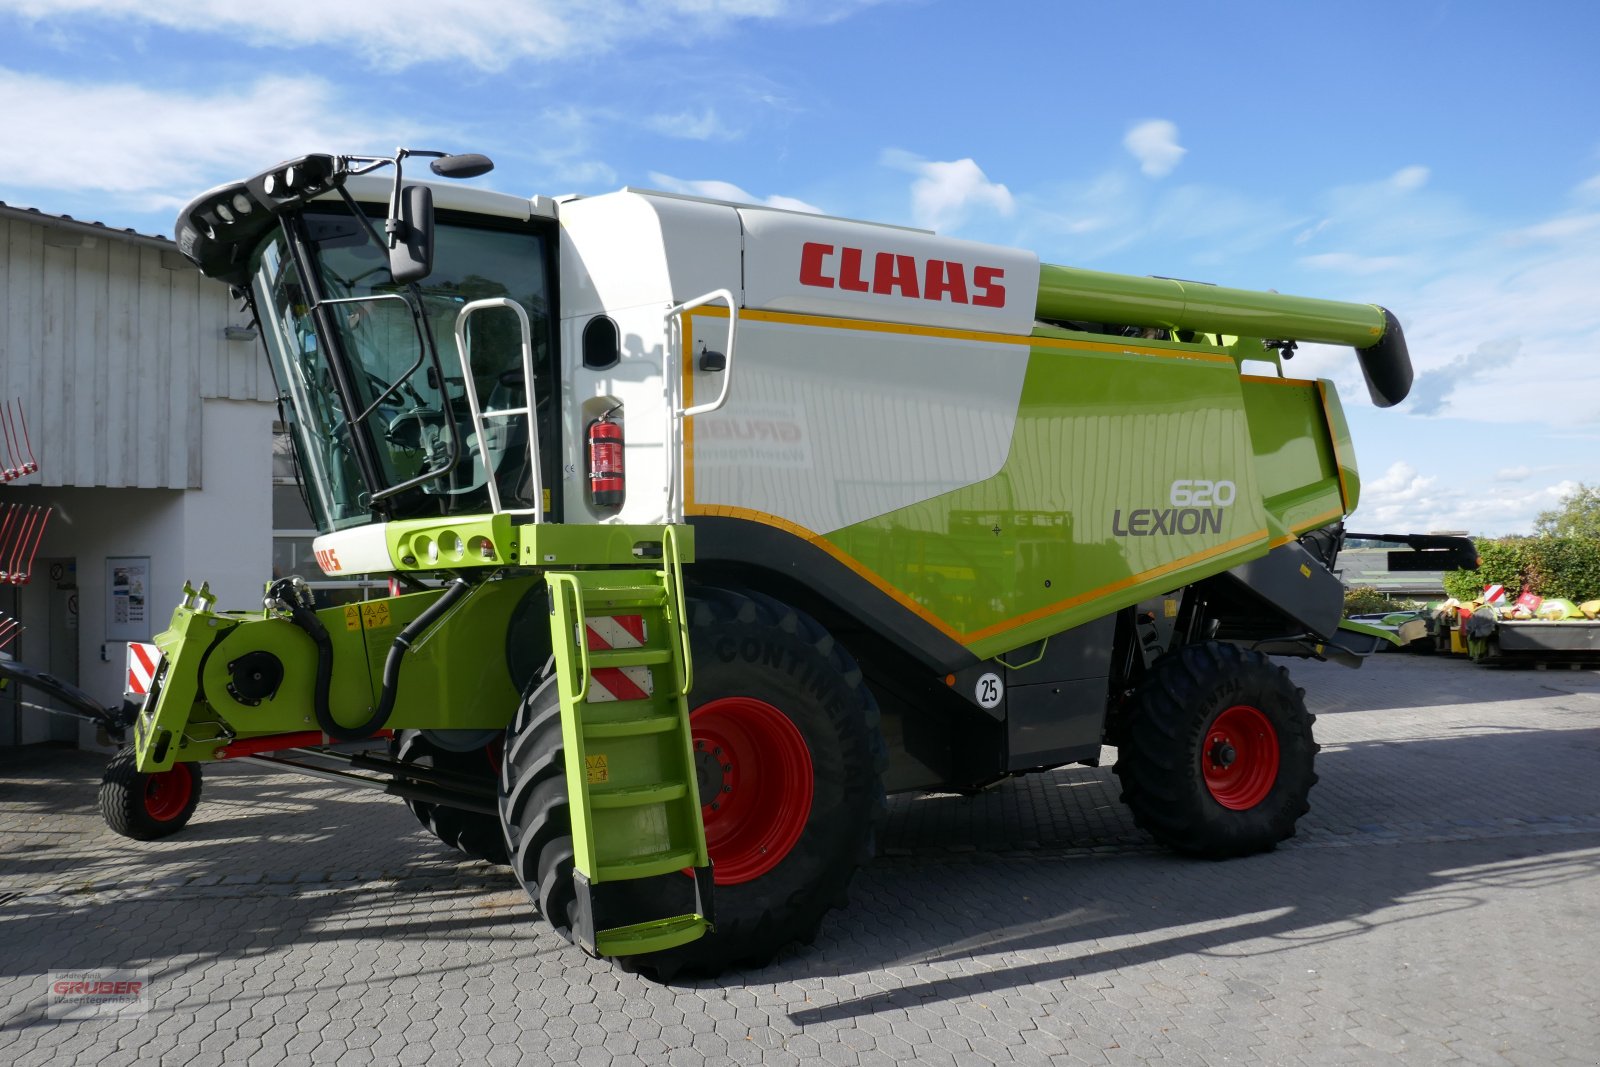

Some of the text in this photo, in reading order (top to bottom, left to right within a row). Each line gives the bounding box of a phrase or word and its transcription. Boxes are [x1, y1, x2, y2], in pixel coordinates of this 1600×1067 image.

[799, 242, 1005, 307] CLAAS
[1170, 480, 1236, 507] 620
[1112, 508, 1223, 536] LEXION
[981, 679, 998, 702] 25
